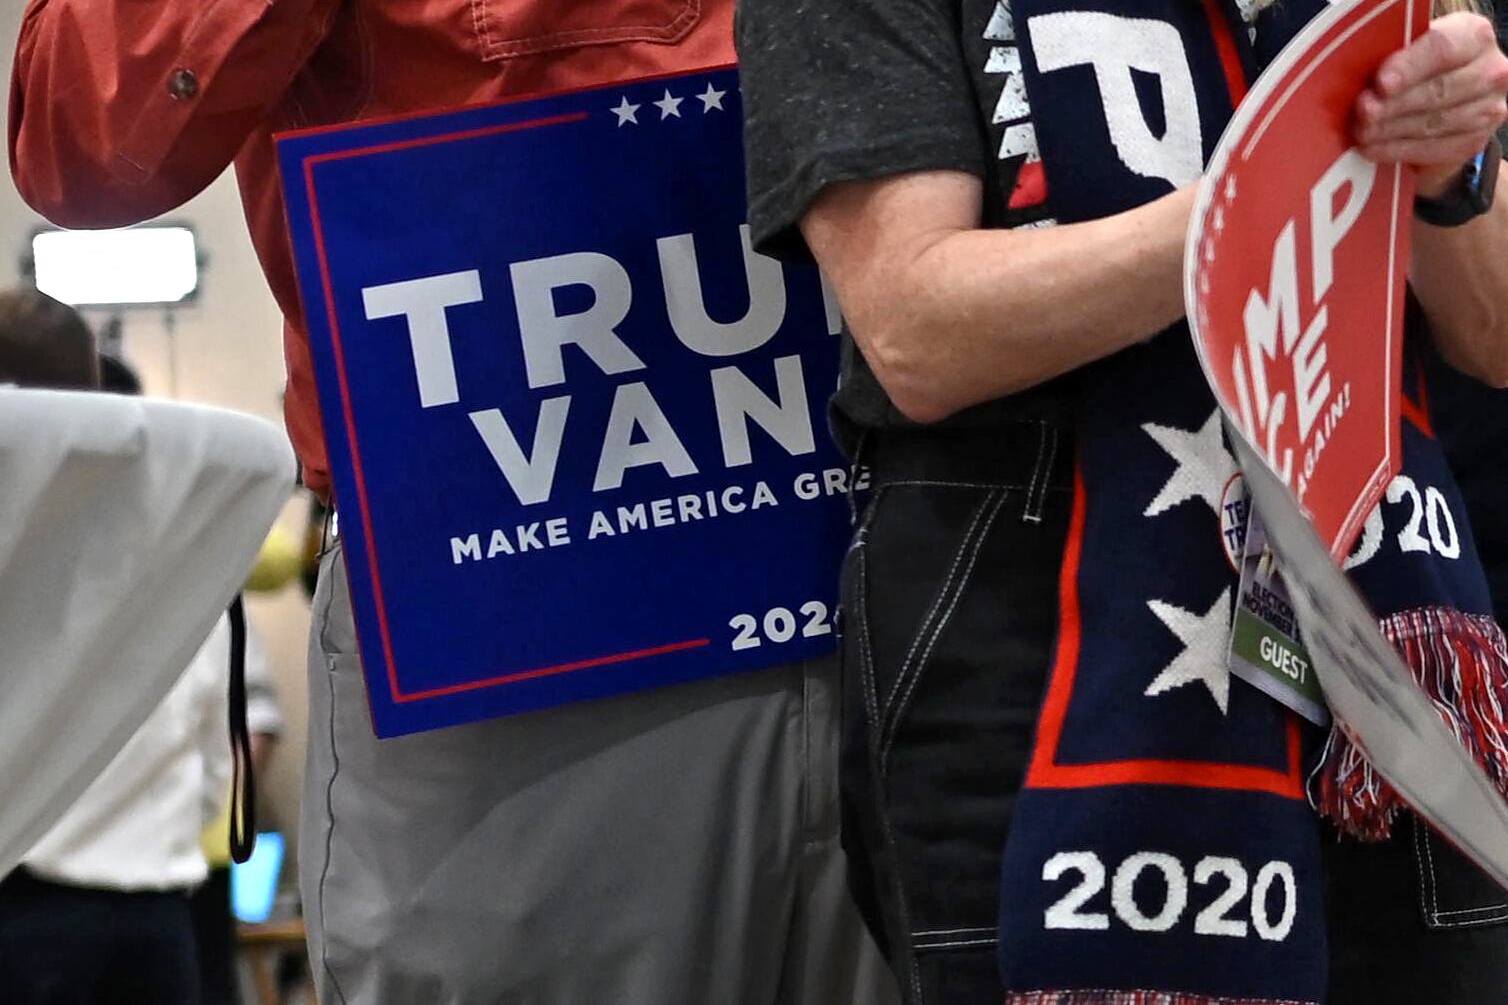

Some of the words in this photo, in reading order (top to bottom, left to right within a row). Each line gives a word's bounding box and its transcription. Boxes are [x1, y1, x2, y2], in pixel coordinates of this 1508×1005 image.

[361, 223, 843, 409] TRU
[468, 354, 841, 506] VAN
[450, 517, 571, 565] MAKE
[587, 485, 778, 540] AMERICA
[728, 600, 841, 652] 202
[1260, 636, 1309, 684] GUEST
[1041, 850, 1298, 942] 2020
